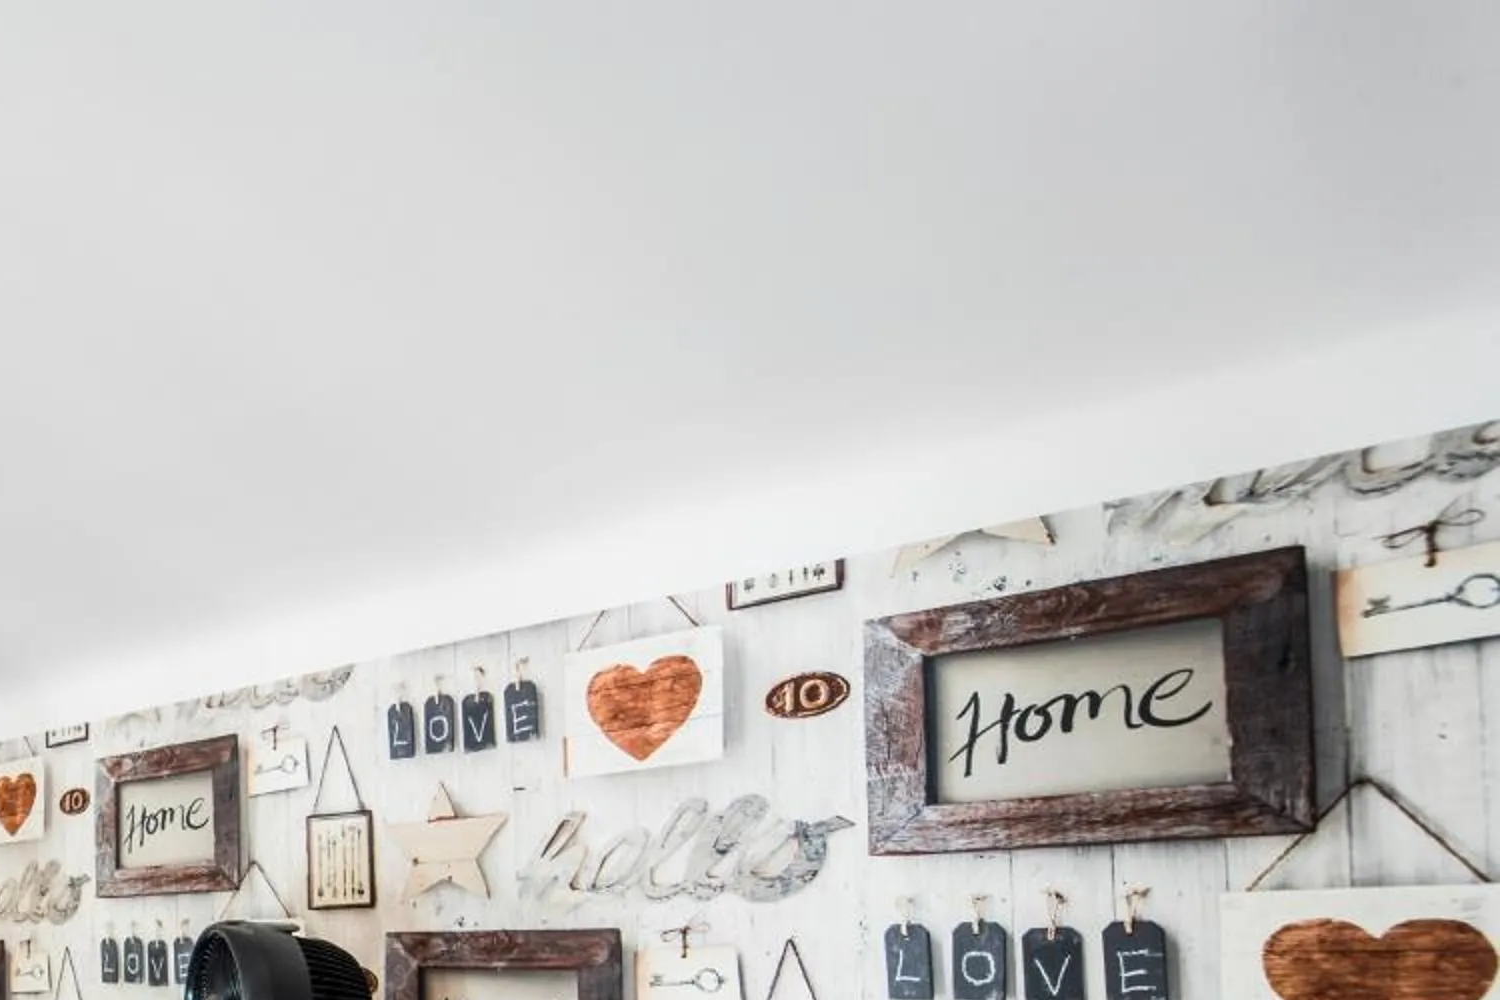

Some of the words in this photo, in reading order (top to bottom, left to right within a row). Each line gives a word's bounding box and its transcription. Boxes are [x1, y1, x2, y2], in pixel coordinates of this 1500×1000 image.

[775, 679, 829, 714] 10
[392, 699, 533, 745] LOVE
[948, 668, 1213, 778] Home
[64, 792, 85, 811] 10
[124, 797, 211, 854] Home
[103, 952, 190, 979] LOVE
[894, 949, 1164, 995] LOVE
